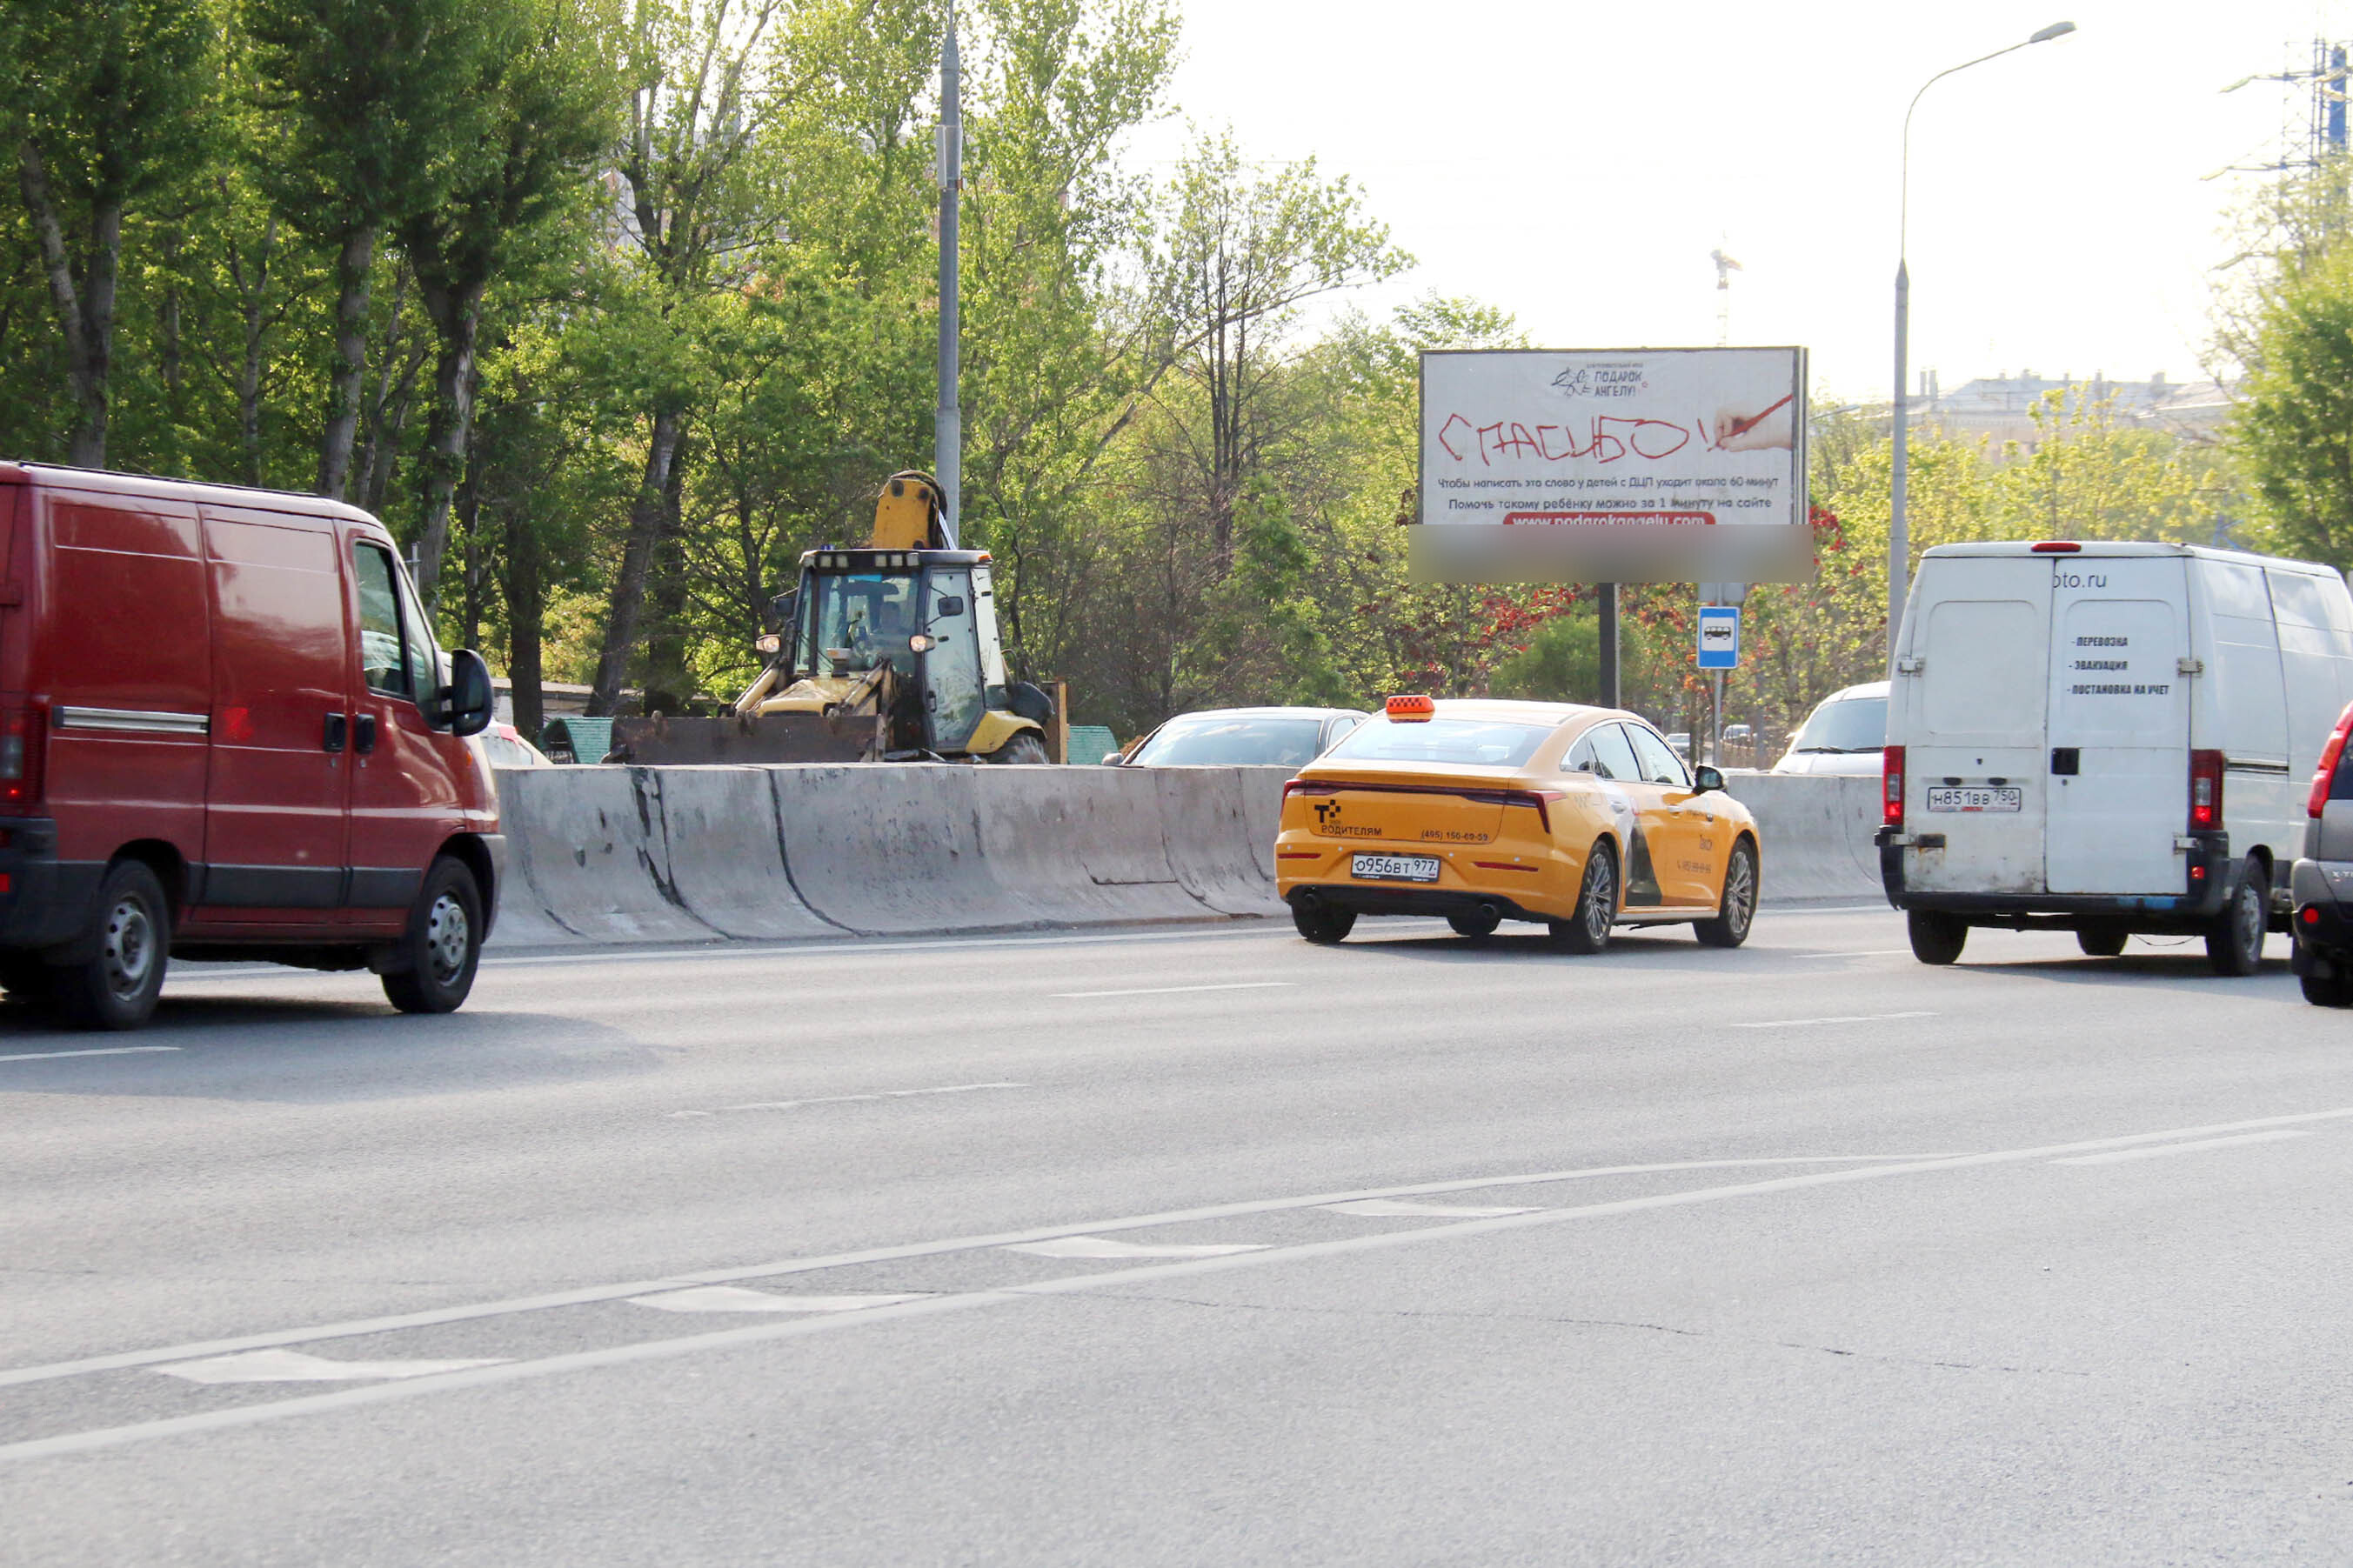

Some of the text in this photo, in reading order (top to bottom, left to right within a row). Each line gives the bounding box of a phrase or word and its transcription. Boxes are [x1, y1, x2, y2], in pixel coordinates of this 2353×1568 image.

[1594, 370, 1642, 384] ПОДАРОК
[1594, 385, 1636, 397] АНГЕЛУ!
[1438, 478, 1470, 488] Чтобы
[1474, 479, 1522, 488] написать
[1578, 479, 1584, 489] у
[1586, 477, 1617, 488] детей
[1628, 477, 1654, 489] ДЦП
[1655, 478, 1692, 489] уходит
[1695, 478, 1727, 487] около
[1729, 477, 1744, 487] 60
[1746, 478, 1779, 489] минут
[1448, 499, 1495, 510] Помочь
[1499, 500, 1540, 510] такому
[1595, 499, 1637, 509] можно
[1641, 499, 1655, 509] за
[1659, 497, 1666, 508] 1
[1671, 498, 1714, 510] минуту
[1717, 499, 1733, 508] на
[1736, 497, 1773, 508] сайте
[1513, 514, 1705, 525] wwwpodarokangelucom
[2076, 637, 2129, 647] ПЕРЕВОЗКА
[2074, 660, 2129, 671] ЭВАКУАЦИЯ
[2072, 684, 2131, 695] ПОСТАНОВКА
[2134, 684, 2146, 695] НА
[1321, 824, 1382, 836] ВОДИТЕЛЯМ
